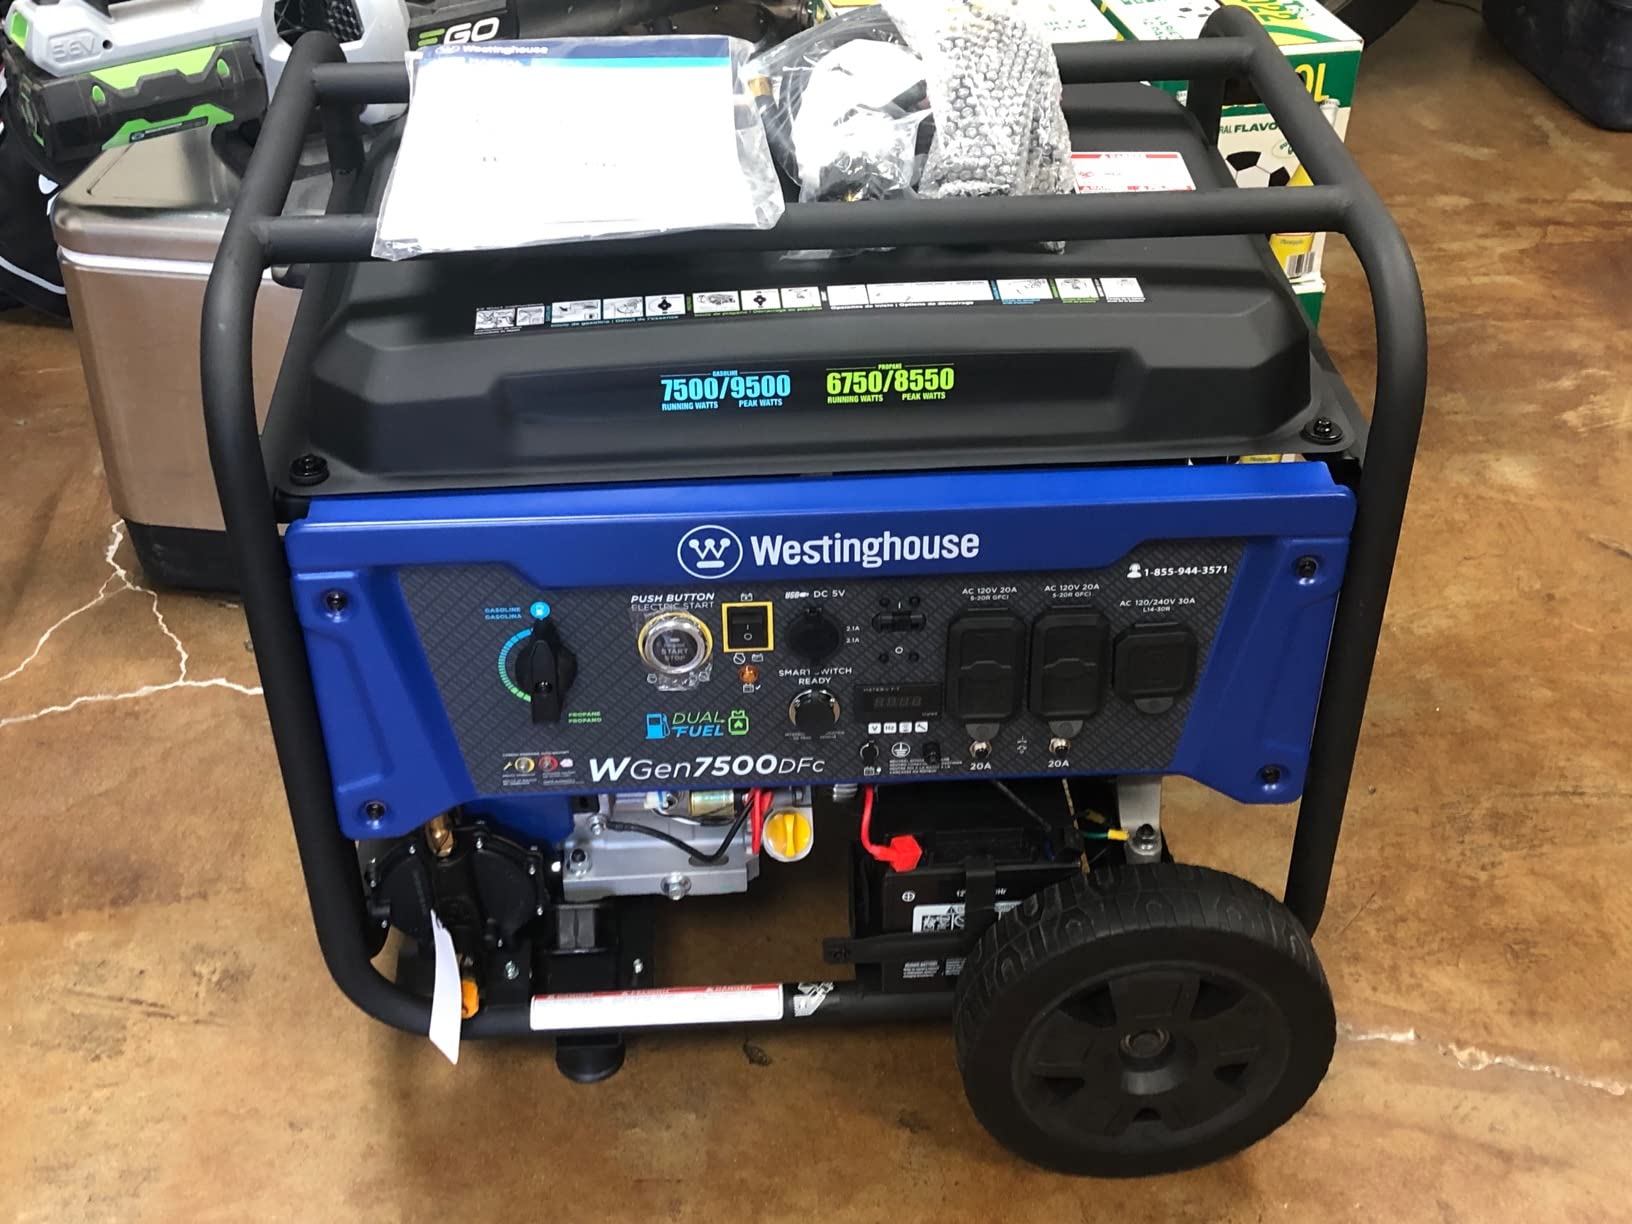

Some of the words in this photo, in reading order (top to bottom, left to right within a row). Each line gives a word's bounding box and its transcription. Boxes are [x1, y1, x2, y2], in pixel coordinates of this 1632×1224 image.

[417, 16, 500, 46] EGO
[52, 32, 95, 63] 56V
[826, 367, 955, 395] 6750/8550
[661, 374, 791, 401] 7500/9500
[827, 395, 859, 404] RUNNING
[860, 394, 884, 403] WATTS
[902, 392, 921, 401] PEAK
[922, 391, 946, 400] WATTS
[662, 402, 694, 411] RUNNING
[695, 401, 718, 410] WATTS
[739, 400, 758, 408] PEAK
[759, 399, 783, 407] WATTS
[751, 530, 980, 568] Westinghouse
[1144, 565, 1228, 577] 1-855-944-3571
[631, 595, 663, 603] PUSH
[666, 592, 715, 602] BUTTON
[813, 590, 828, 598] DC
[832, 589, 846, 597] 5V
[631, 603, 680, 612] ELECTRIC
[682, 601, 714, 610] START
[1135, 598, 1176, 606] 120/240V
[1178, 597, 1195, 605] 30A
[798, 677, 831, 685] READY
[672, 711, 722, 725] DUAL
[672, 724, 724, 738] FUEL
[969, 761, 992, 771] 20A
[1048, 759, 1070, 768] 20A
